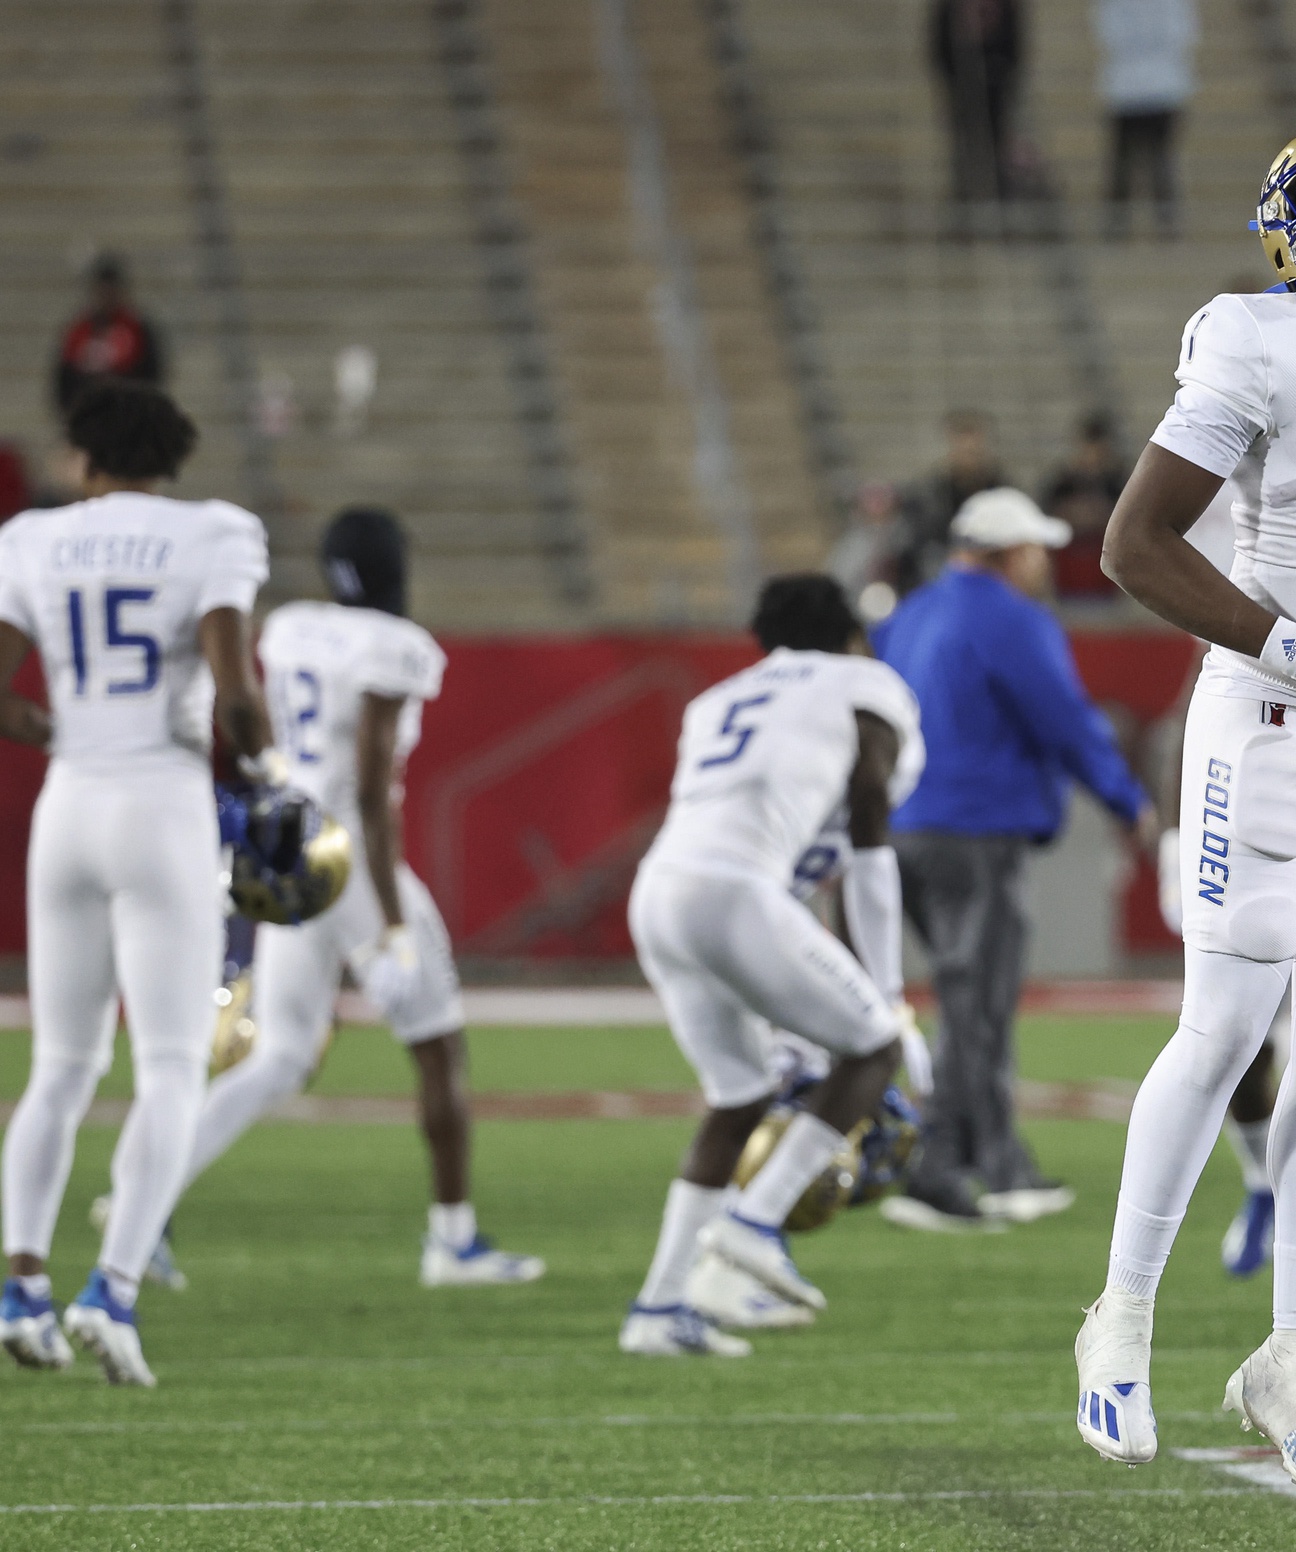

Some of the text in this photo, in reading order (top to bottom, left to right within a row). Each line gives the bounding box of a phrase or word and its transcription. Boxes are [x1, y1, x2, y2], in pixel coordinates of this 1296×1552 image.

[68, 587, 159, 695] 15
[698, 692, 774, 769] 5
[1197, 756, 1234, 908] GOLDEN
